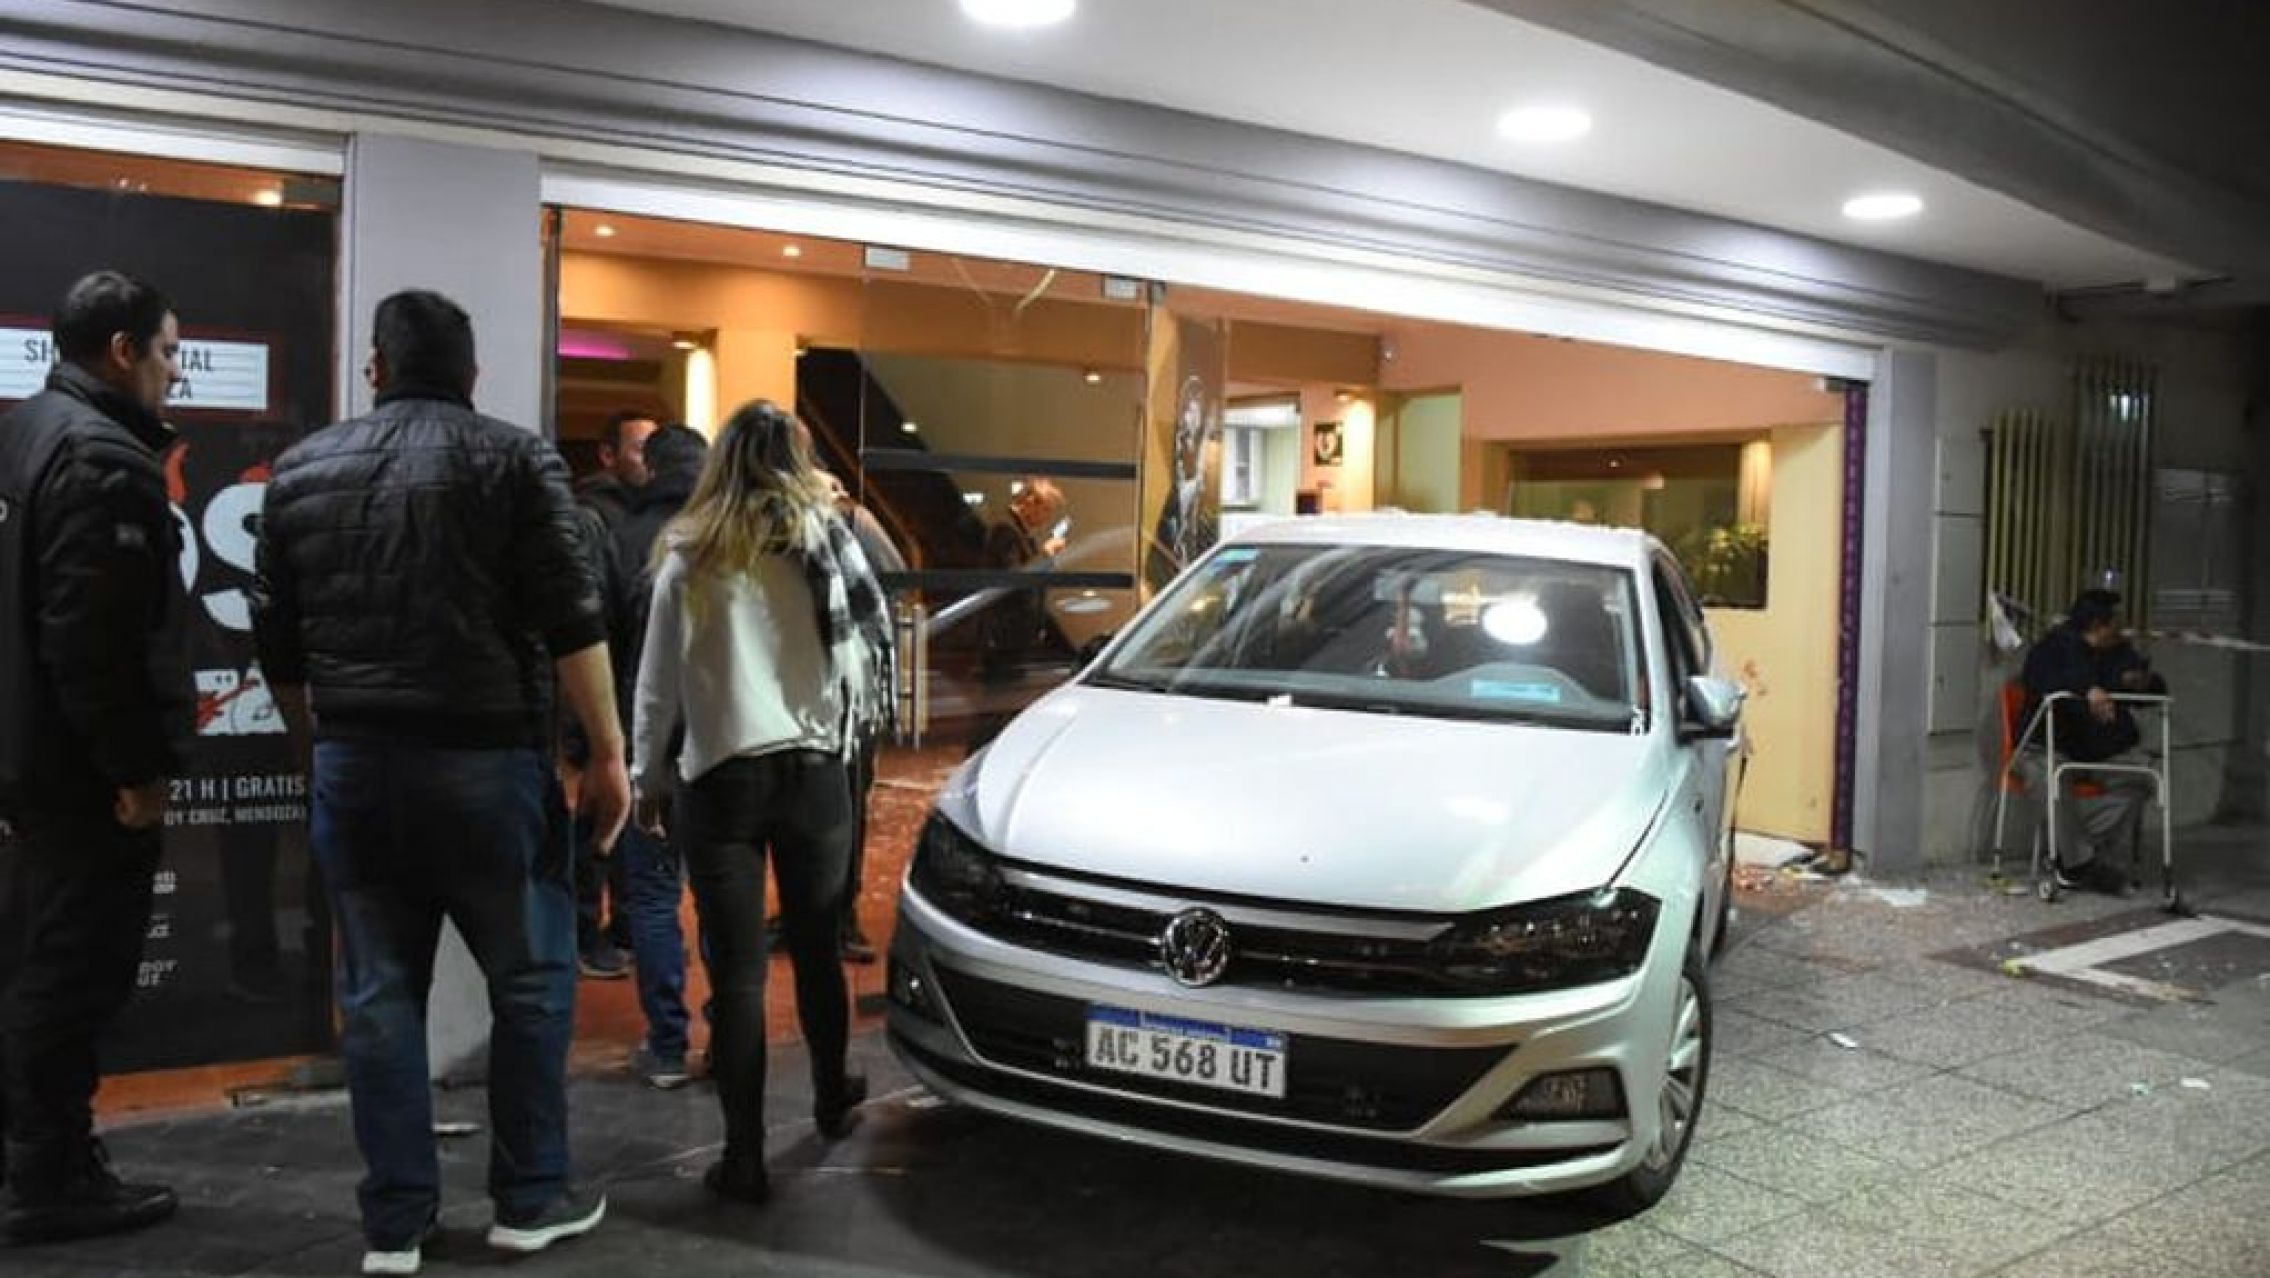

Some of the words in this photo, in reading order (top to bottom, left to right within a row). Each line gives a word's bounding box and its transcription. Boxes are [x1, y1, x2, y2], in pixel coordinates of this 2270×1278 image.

[181, 350, 214, 371] IAL
[169, 779, 192, 801] 21
[201, 778, 214, 799] H
[236, 775, 305, 798] GRATIS
[1096, 1027, 1139, 1066] AC
[1151, 1034, 1217, 1079] 568
[1230, 1049, 1275, 1090] UT
